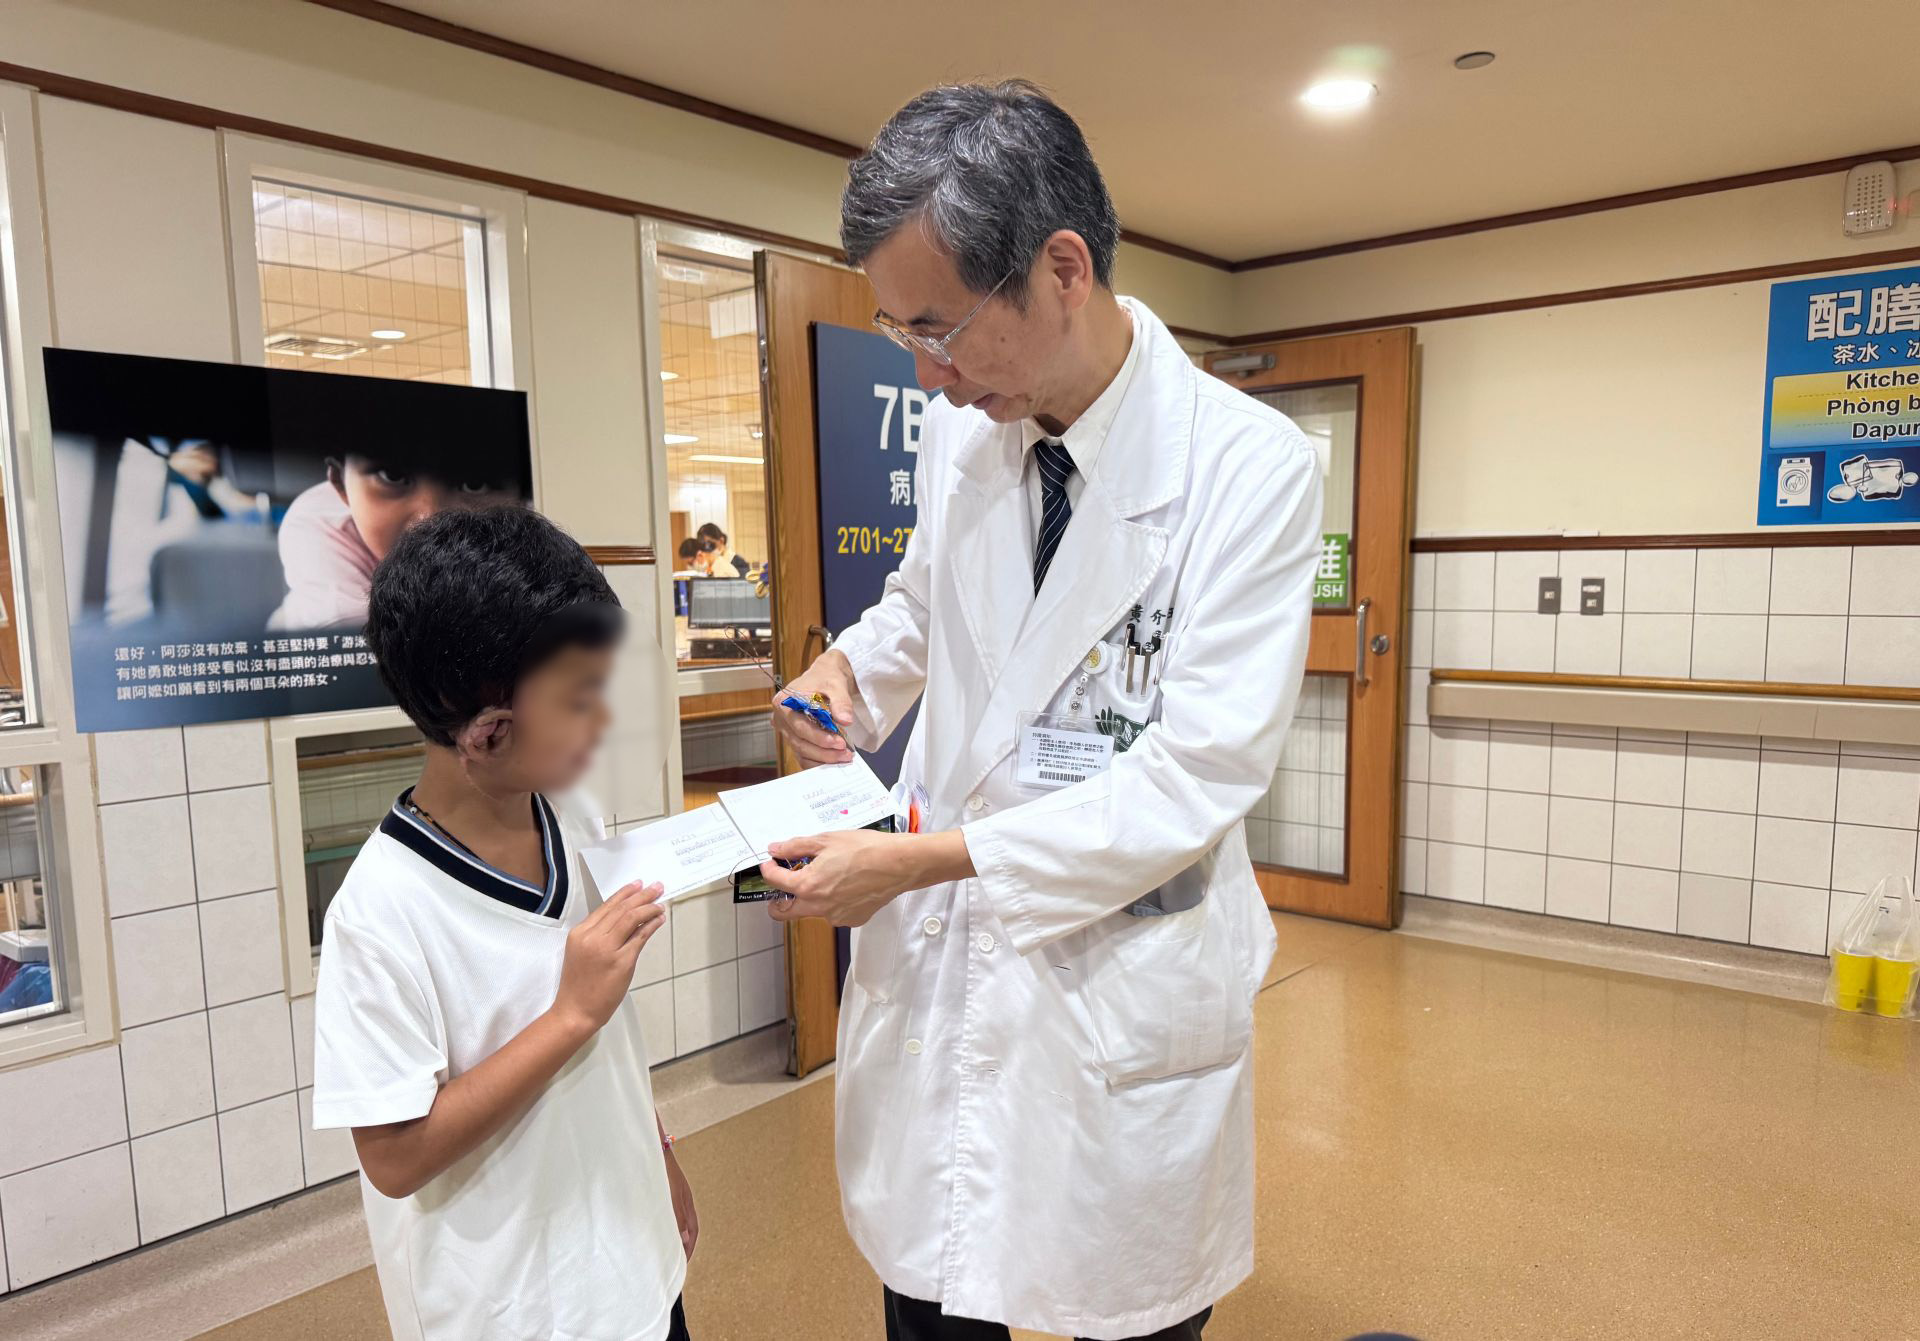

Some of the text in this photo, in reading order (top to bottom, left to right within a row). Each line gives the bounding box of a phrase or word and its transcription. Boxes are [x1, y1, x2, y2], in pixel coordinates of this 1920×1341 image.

[1807, 282, 1920, 341] 配膳
[873, 383, 930, 453] 7B
[1827, 397, 1901, 416] Phòng
[889, 468, 918, 506] 病
[1313, 584, 1344, 598] USH
